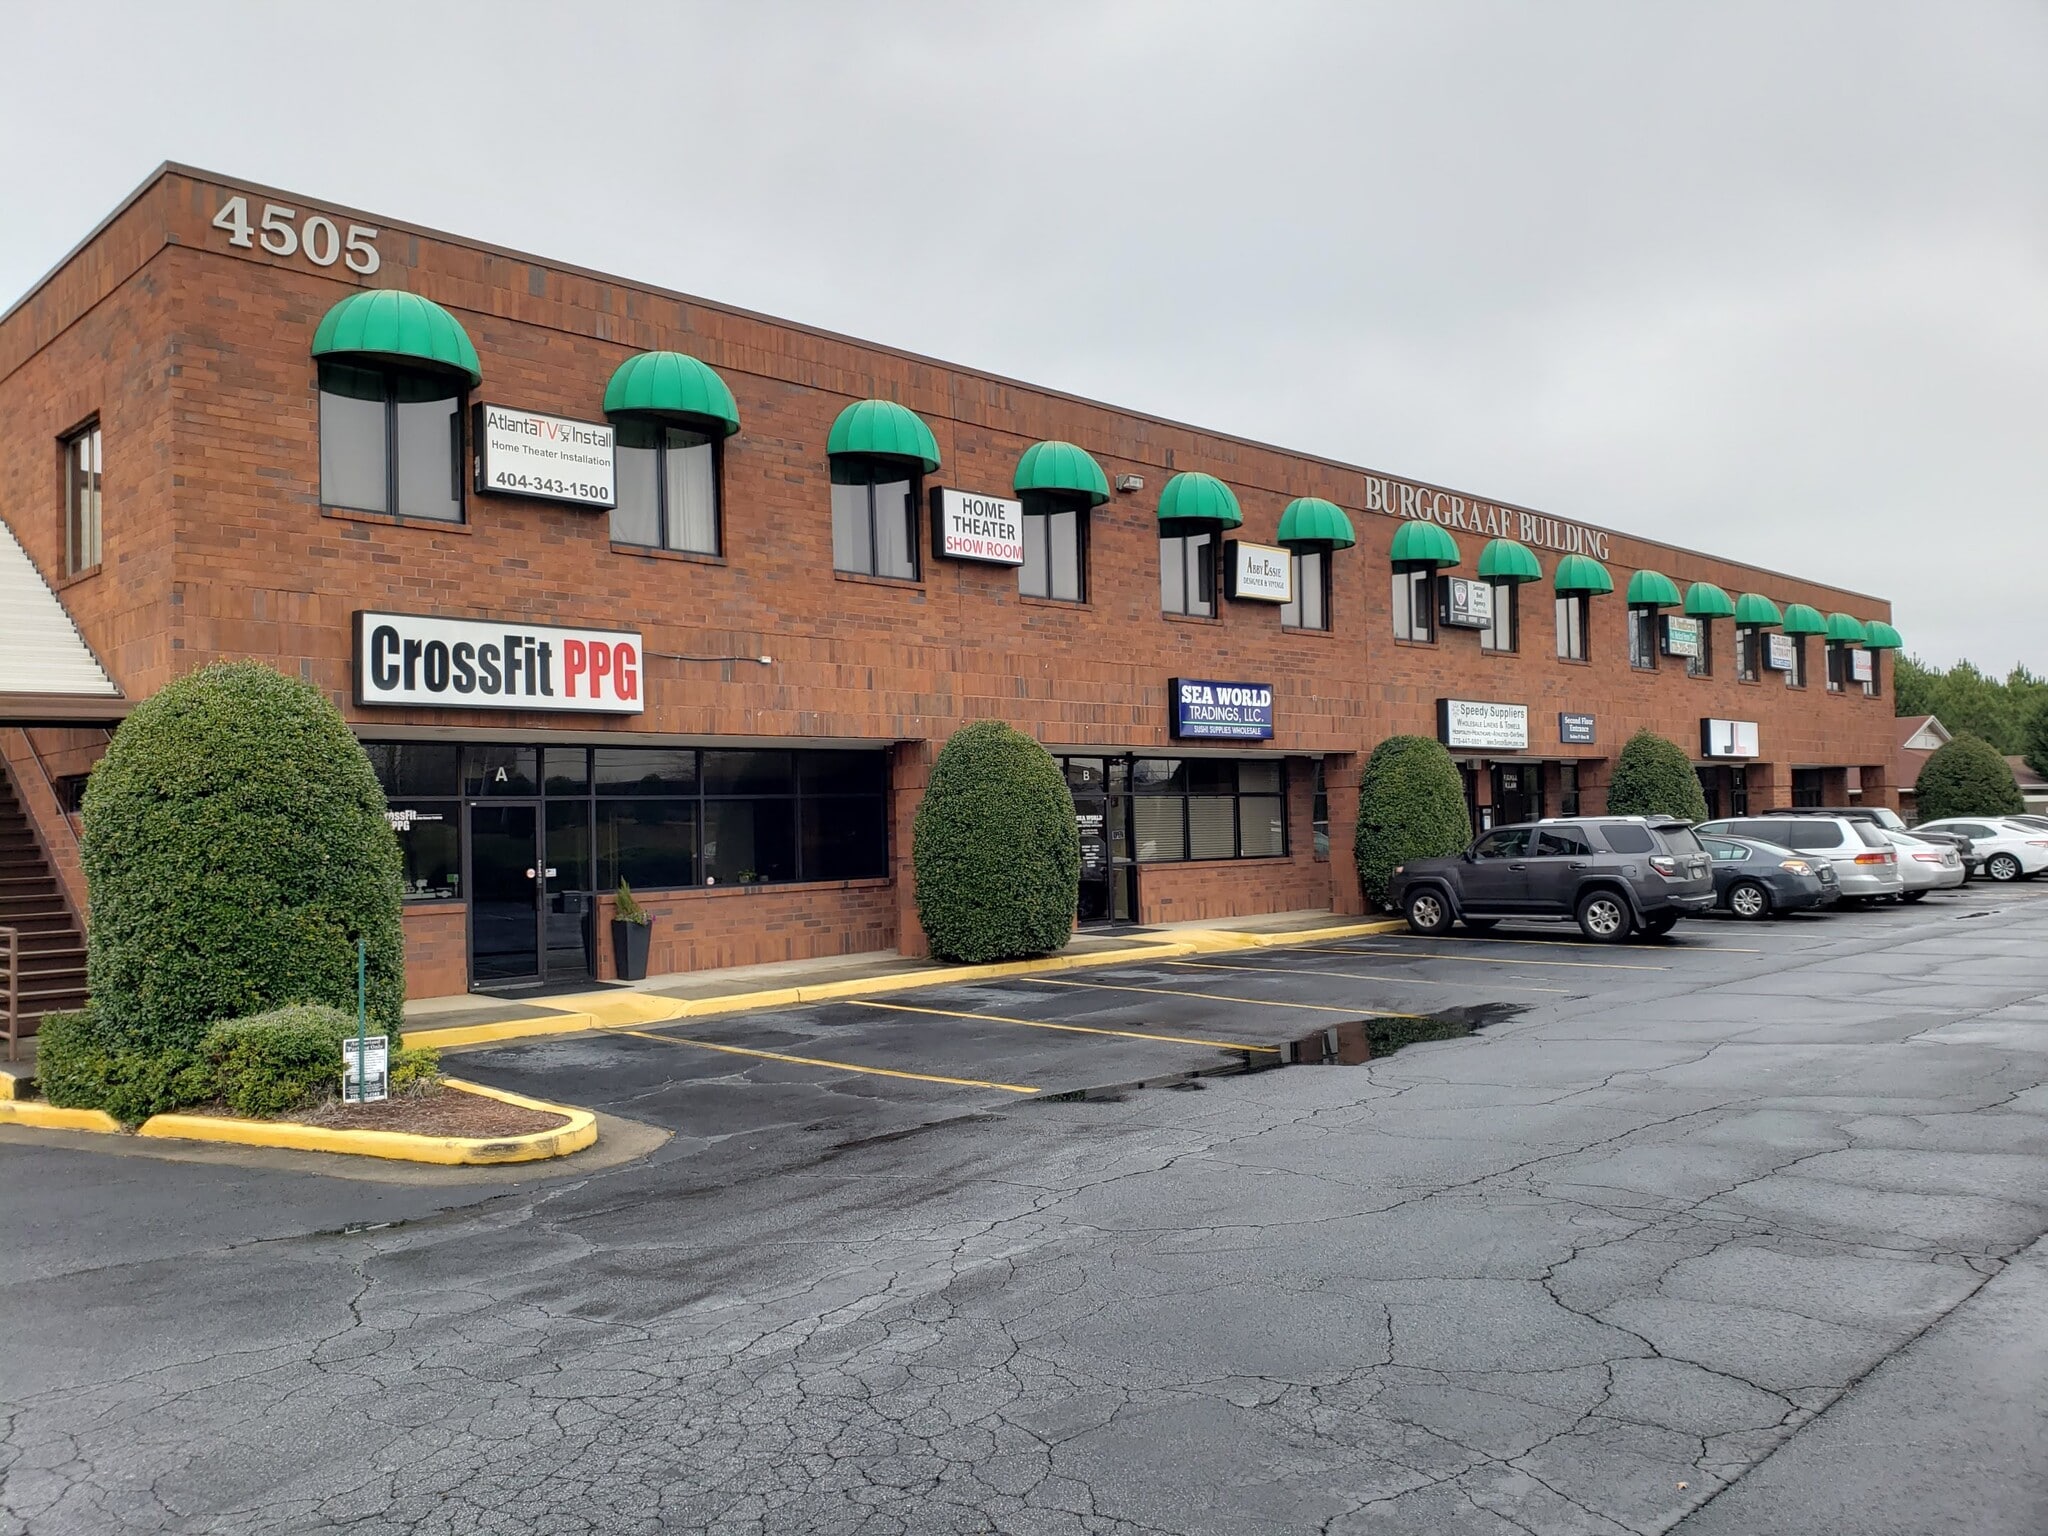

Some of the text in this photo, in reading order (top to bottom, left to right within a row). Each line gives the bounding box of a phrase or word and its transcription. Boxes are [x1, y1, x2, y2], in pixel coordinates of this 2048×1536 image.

[212, 196, 381, 275] 4505
[572, 426, 612, 448] Install
[491, 439, 611, 467] Home Theater Installation
[496, 471, 609, 500] 404-343-1500
[962, 497, 1006, 521] HOME
[1364, 476, 1610, 561] BURGGRAAF BUILDING
[952, 515, 1016, 541] THEATER
[946, 535, 1024, 561] SHOW ROOM
[371, 625, 638, 701] CrossFit PPG
[1181, 685, 1271, 708] SEA WORLD
[1189, 705, 1265, 723] TRADINGS, LLC.
[1460, 703, 1525, 721] Speedy Suppliers
[1564, 716, 1594, 725] Second Floor
[1193, 725, 1262, 736] SUSHI SUPPLIES WHOLESALE
[1569, 724, 1590, 733] Entrance
[494, 766, 509, 783] A
[1082, 770, 1091, 782] B
[384, 809, 417, 821] rossFit
[391, 820, 411, 831] PPG
